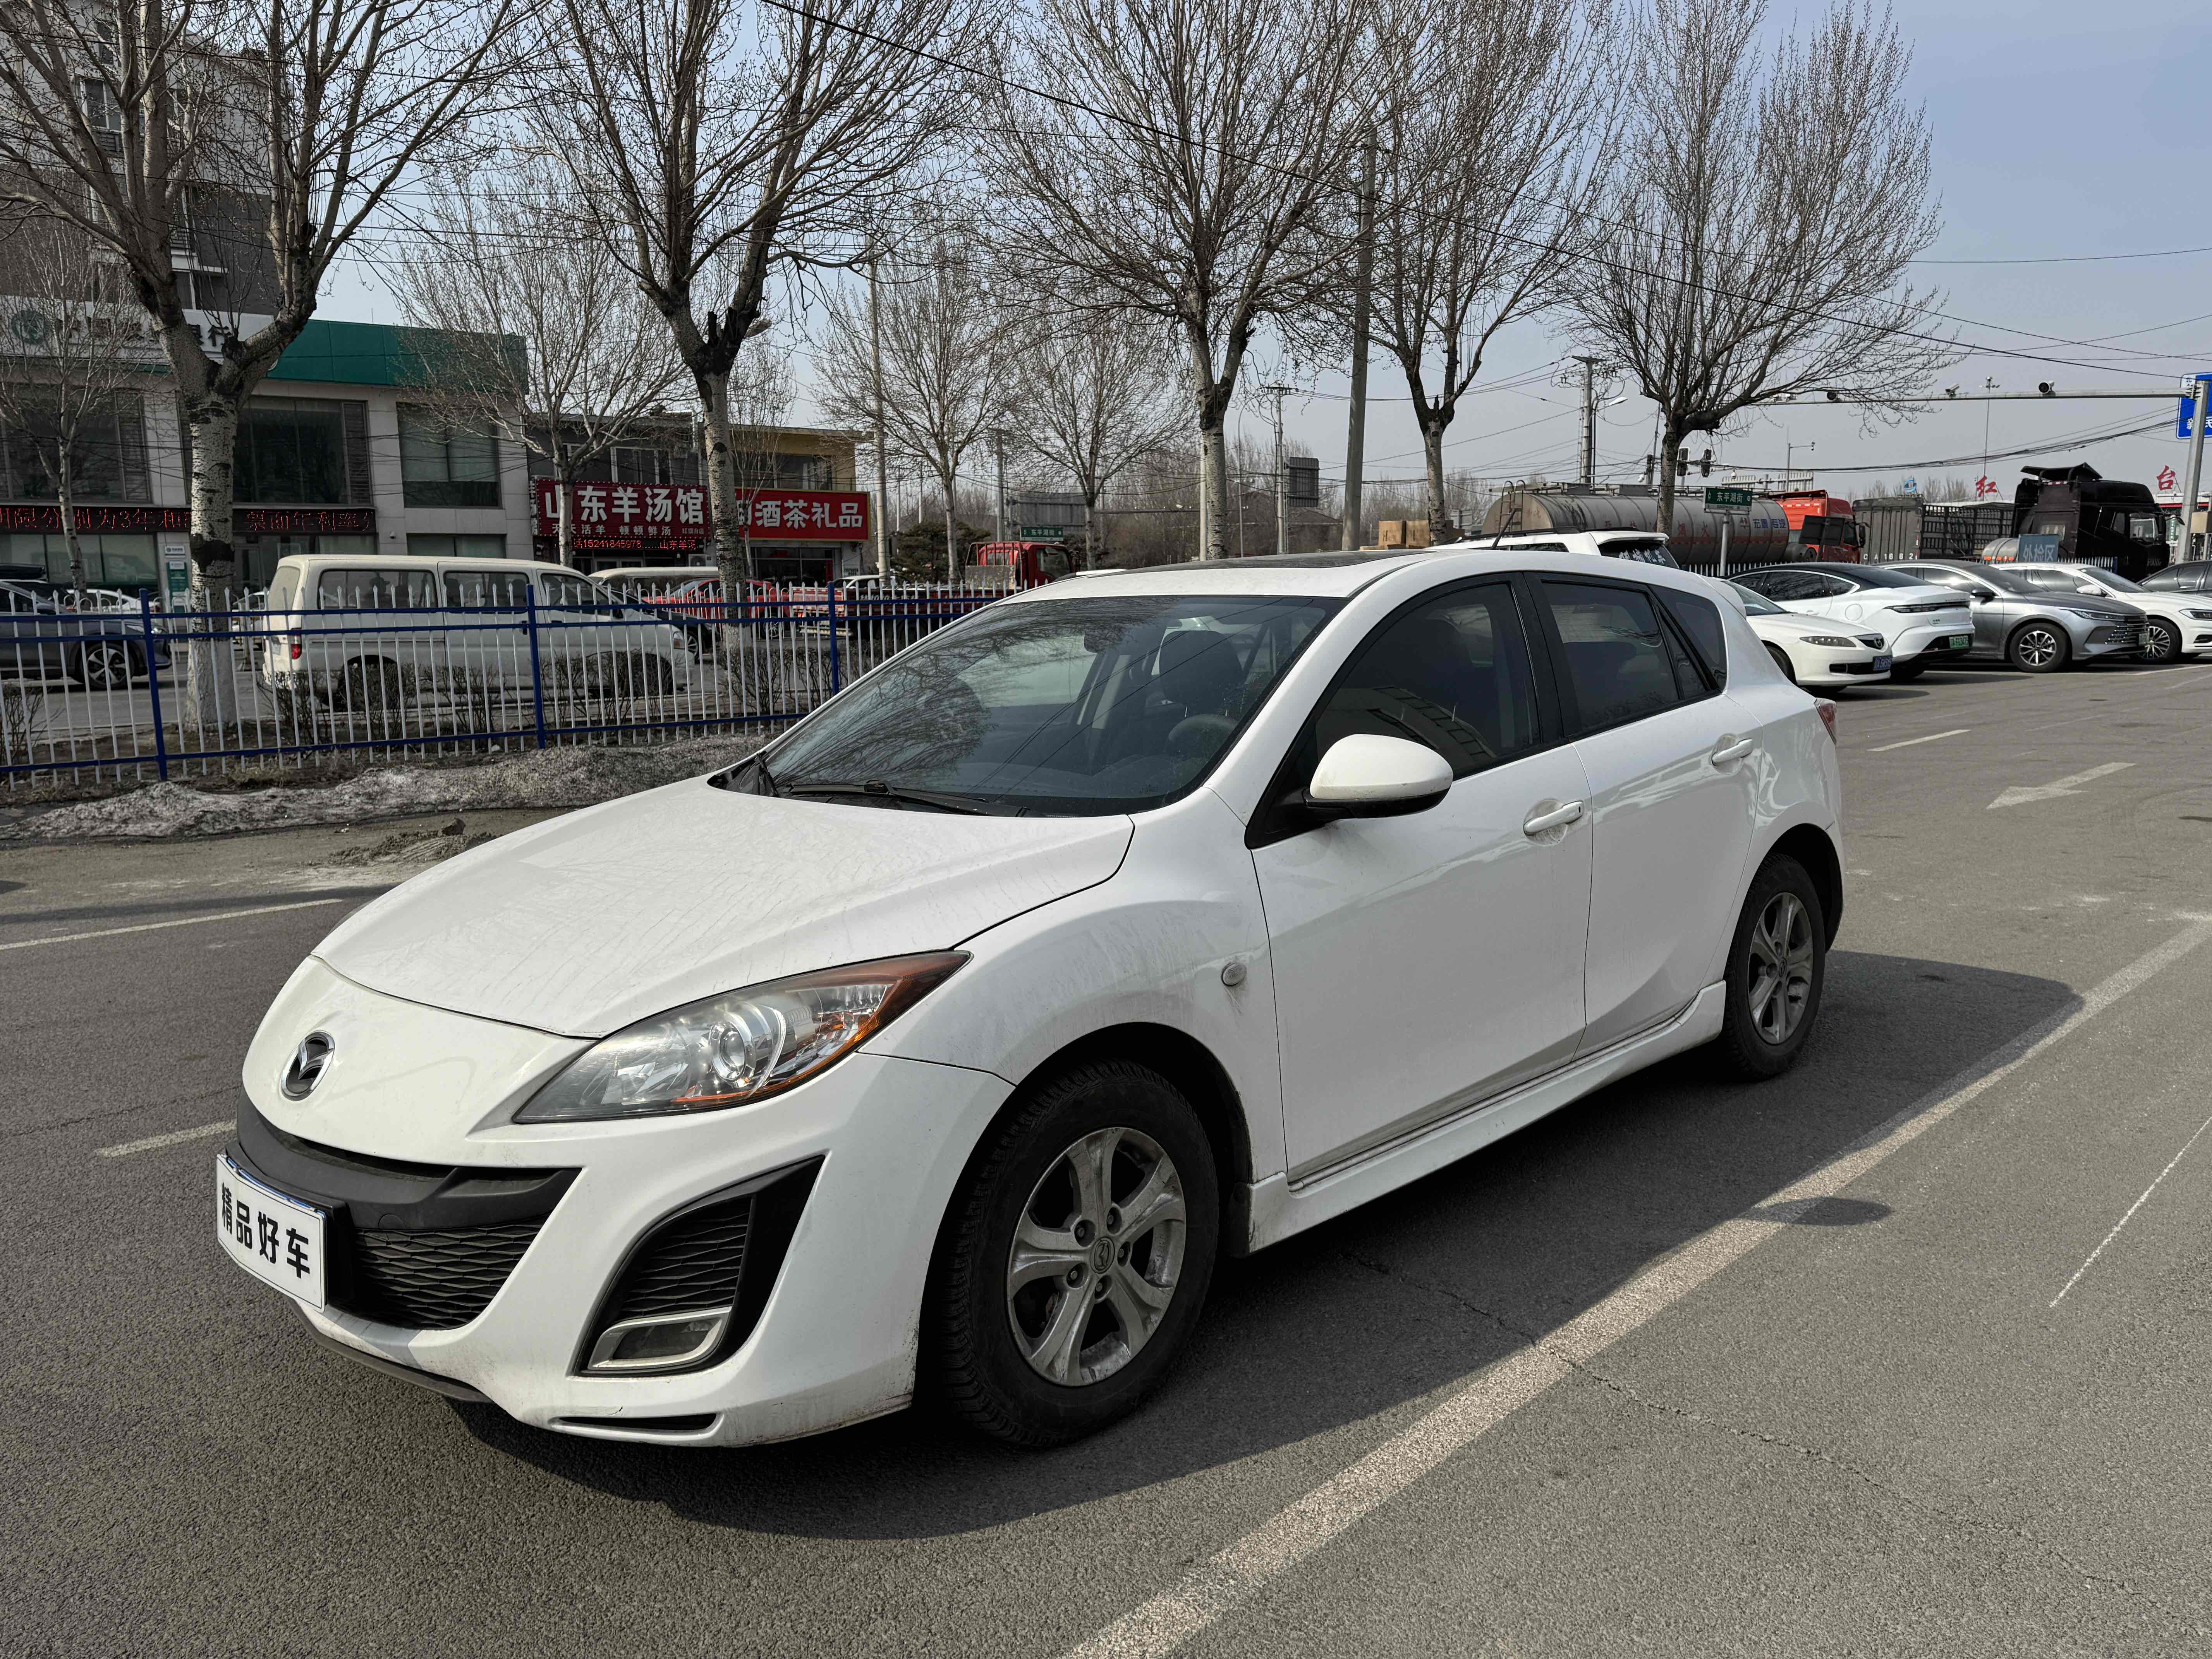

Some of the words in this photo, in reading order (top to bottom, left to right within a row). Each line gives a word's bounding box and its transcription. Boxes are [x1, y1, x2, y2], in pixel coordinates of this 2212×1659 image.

[1975, 476, 1997, 497] 红
[2156, 465, 2175, 490] 台
[545, 485, 704, 524] 山东羊汤馆
[2023, 544, 2056, 561] 外检区
[221, 1182, 310, 1279] 精品好车
